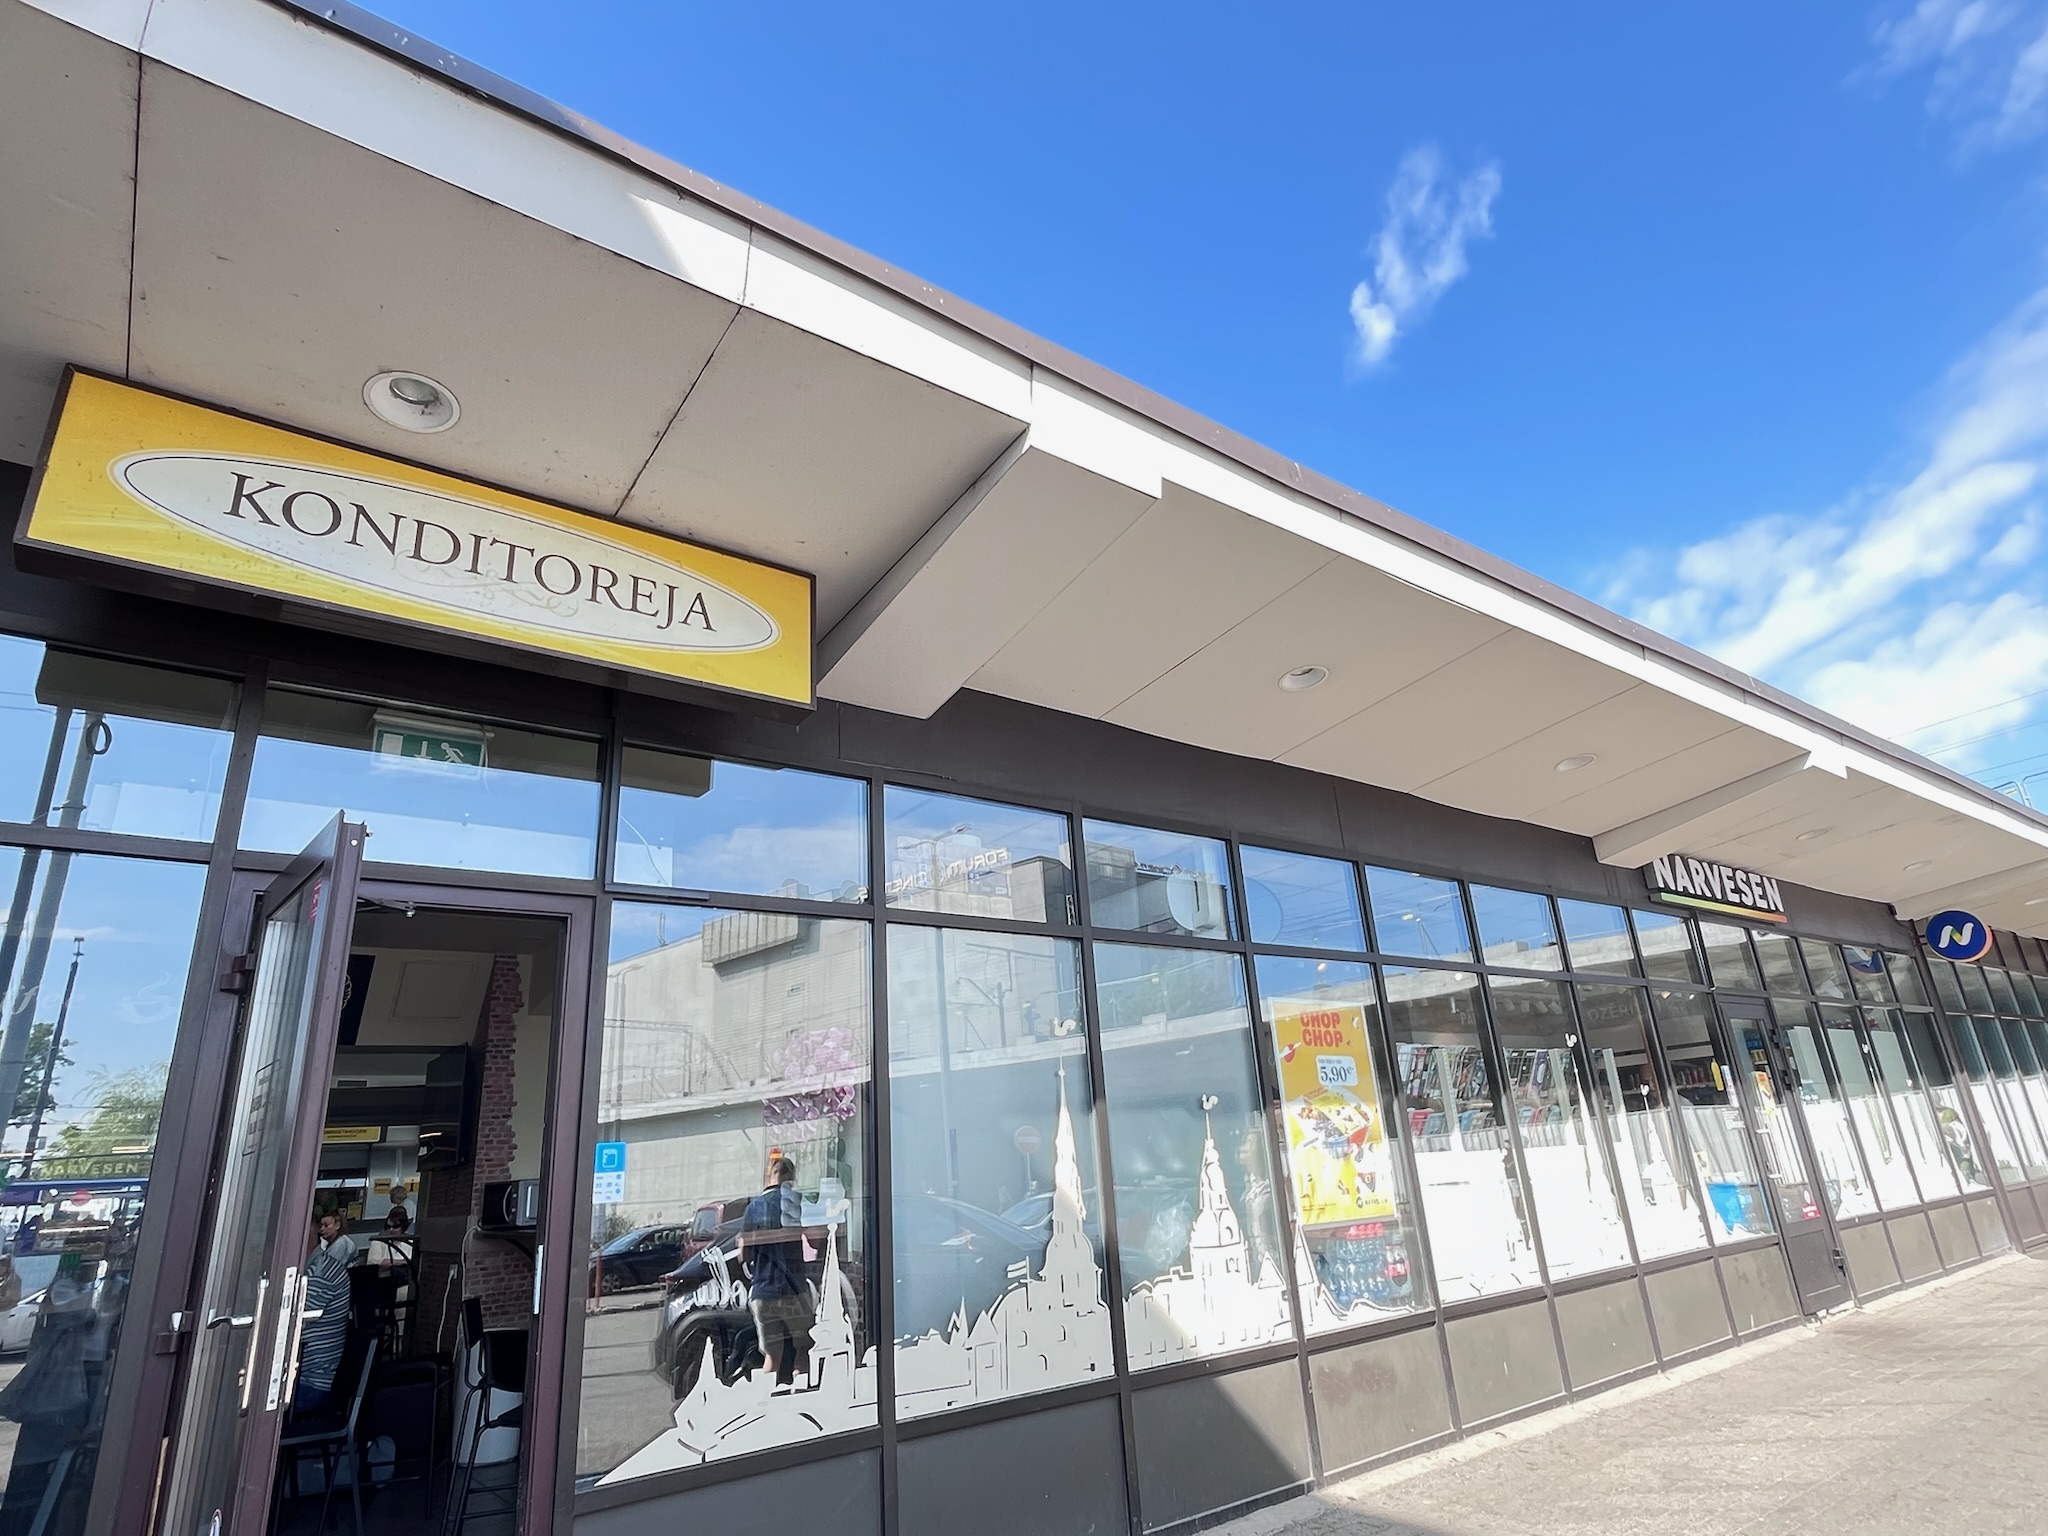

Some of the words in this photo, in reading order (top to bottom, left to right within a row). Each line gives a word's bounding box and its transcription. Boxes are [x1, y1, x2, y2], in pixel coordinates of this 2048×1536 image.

[223, 471, 717, 632] KONDITOREJA
[1652, 854, 1785, 912] NARVESEN
[1300, 1011, 1341, 1029] CHOP
[1302, 1029, 1343, 1048] CHOP
